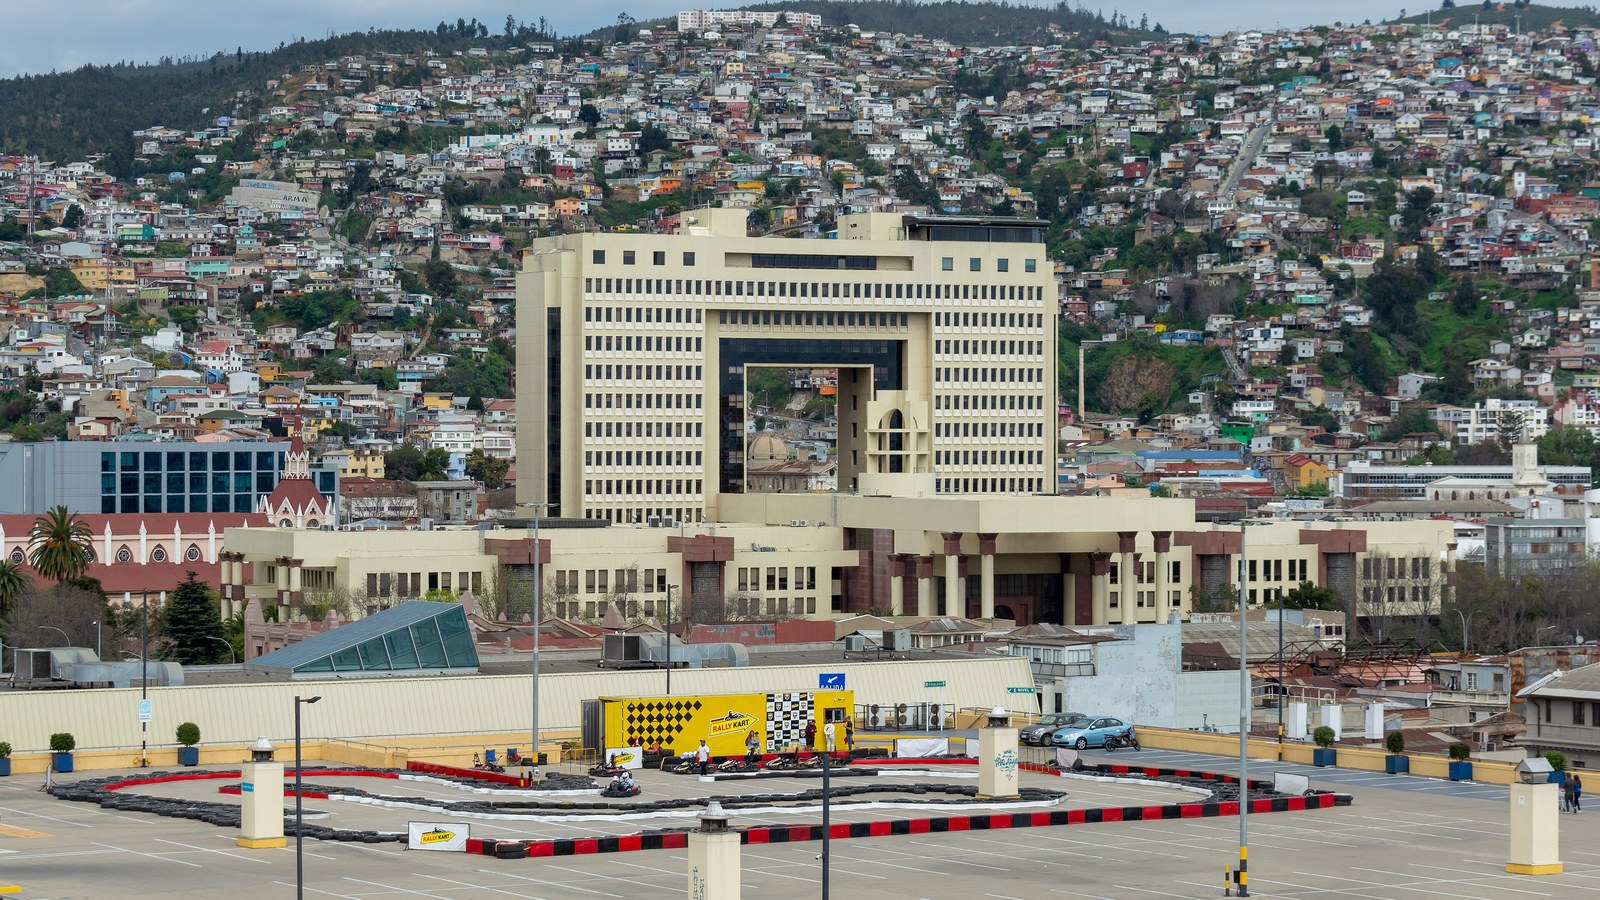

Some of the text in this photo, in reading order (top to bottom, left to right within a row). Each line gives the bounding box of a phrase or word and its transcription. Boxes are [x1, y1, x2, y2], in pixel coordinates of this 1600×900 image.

[283, 195, 308, 203] ARMA
[712, 719, 750, 732] RALLY KART
